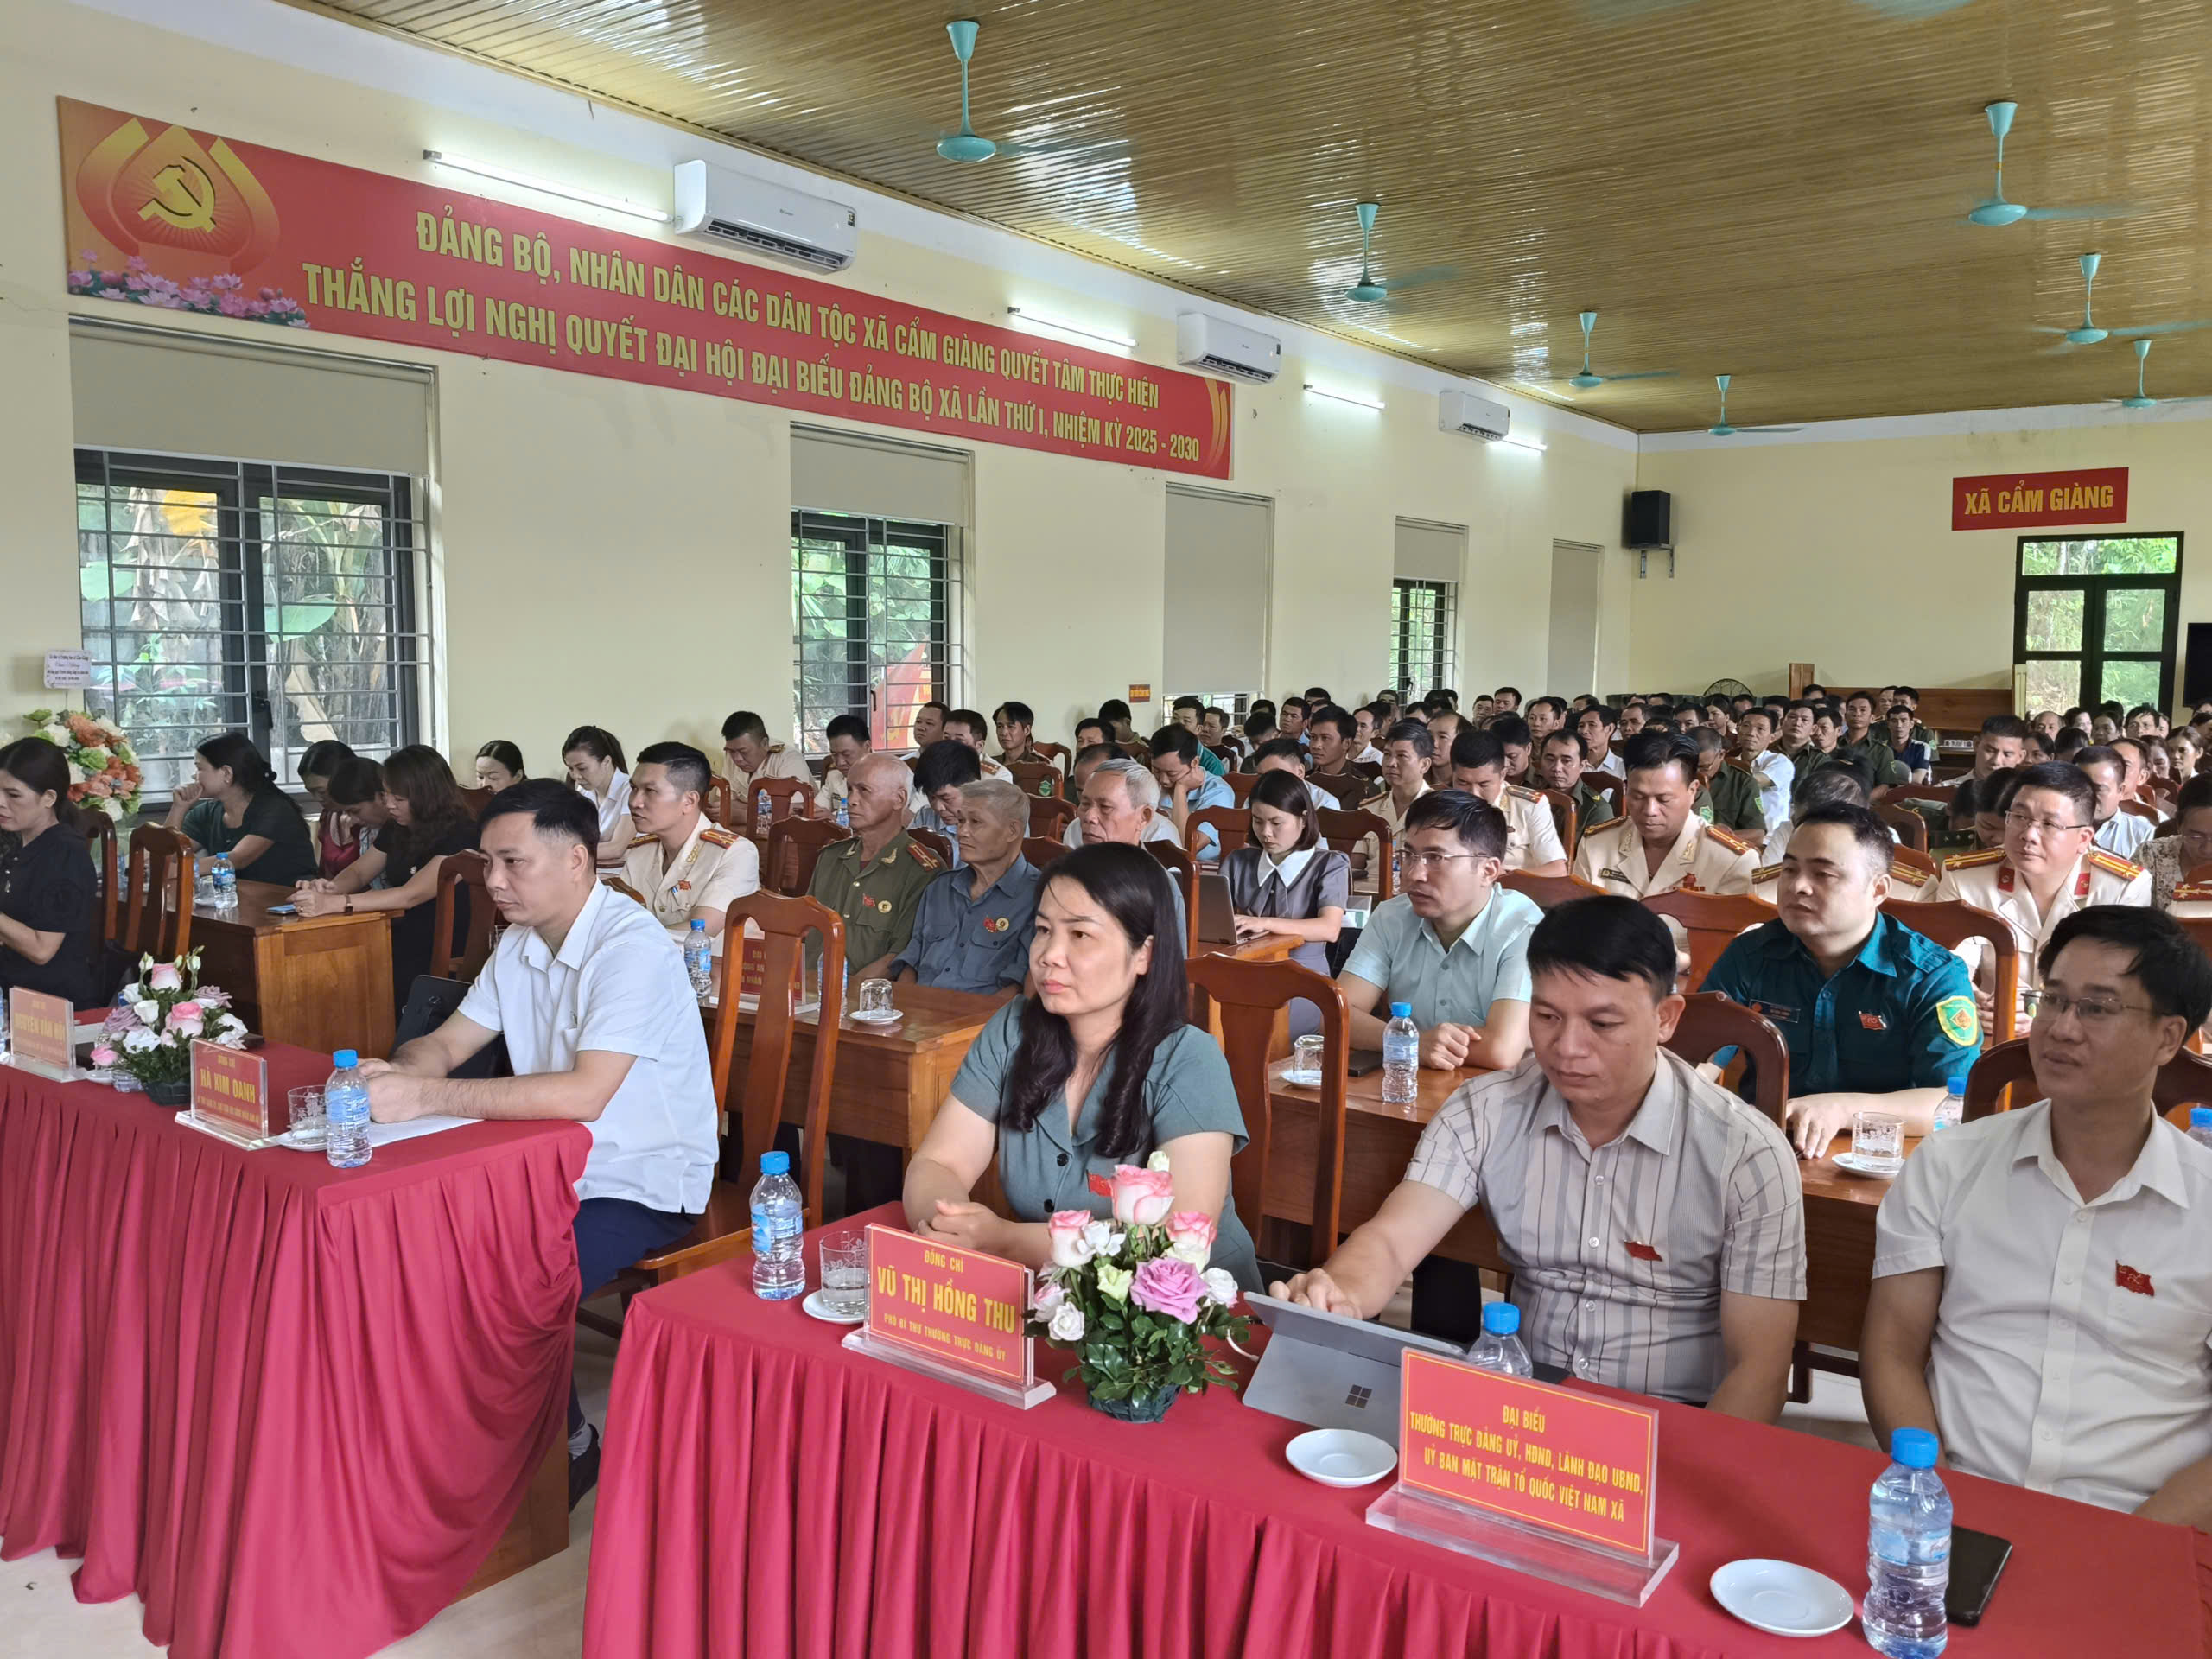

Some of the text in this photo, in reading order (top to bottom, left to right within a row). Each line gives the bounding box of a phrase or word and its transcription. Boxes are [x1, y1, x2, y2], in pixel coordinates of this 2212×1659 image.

[416, 204, 1159, 412] ĐẢNG BỘ, NHÂN DÂN CÁC DÂN TỘC XÃ CẨM GIÀNG QUYẾT TÂM THỰC HIỆN
[302, 257, 416, 321] THẮNG
[427, 286, 474, 338] LỢI
[485, 297, 556, 355] NGHỊ
[565, 315, 648, 363] QUYẾT
[655, 331, 698, 377] ĐẠI
[705, 339, 745, 385] HỘI
[751, 351, 789, 394] ĐẠI
[796, 353, 842, 399] BIỂU
[849, 364, 903, 410] ĐẢNG
[909, 379, 933, 422] BỘ
[938, 385, 963, 420] XÃ
[967, 387, 1000, 427] LẦN
[1005, 400, 1036, 433] THỨ
[1039, 408, 1048, 439] I,
[1053, 410, 1101, 448] NHIỆM
[1104, 416, 1122, 449] KỲ
[1125, 425, 1158, 454] 2025
[1169, 434, 1199, 462] 2030
[1964, 480, 2113, 515] XÃ CẨM GIÀNG
[214, 1072, 230, 1096] KIM
[232, 1078, 256, 1104] OANH
[925, 1249, 963, 1273] ĐỒNG CHÍ
[877, 1265, 1015, 1334] VŨ THỊ HỒNG THU
[1503, 1405, 1546, 1433] ĐẠI BIỂU
[1410, 1411, 1643, 1497] THƯỜNG TRỰC ĐẢNG UỶ, HĐND, LÃNH ĐẠO UBND,
[1424, 1443, 1624, 1522] UỶ BAN MẶT TRẬN TỔ QUỐC VIỆT NAM XÃ
